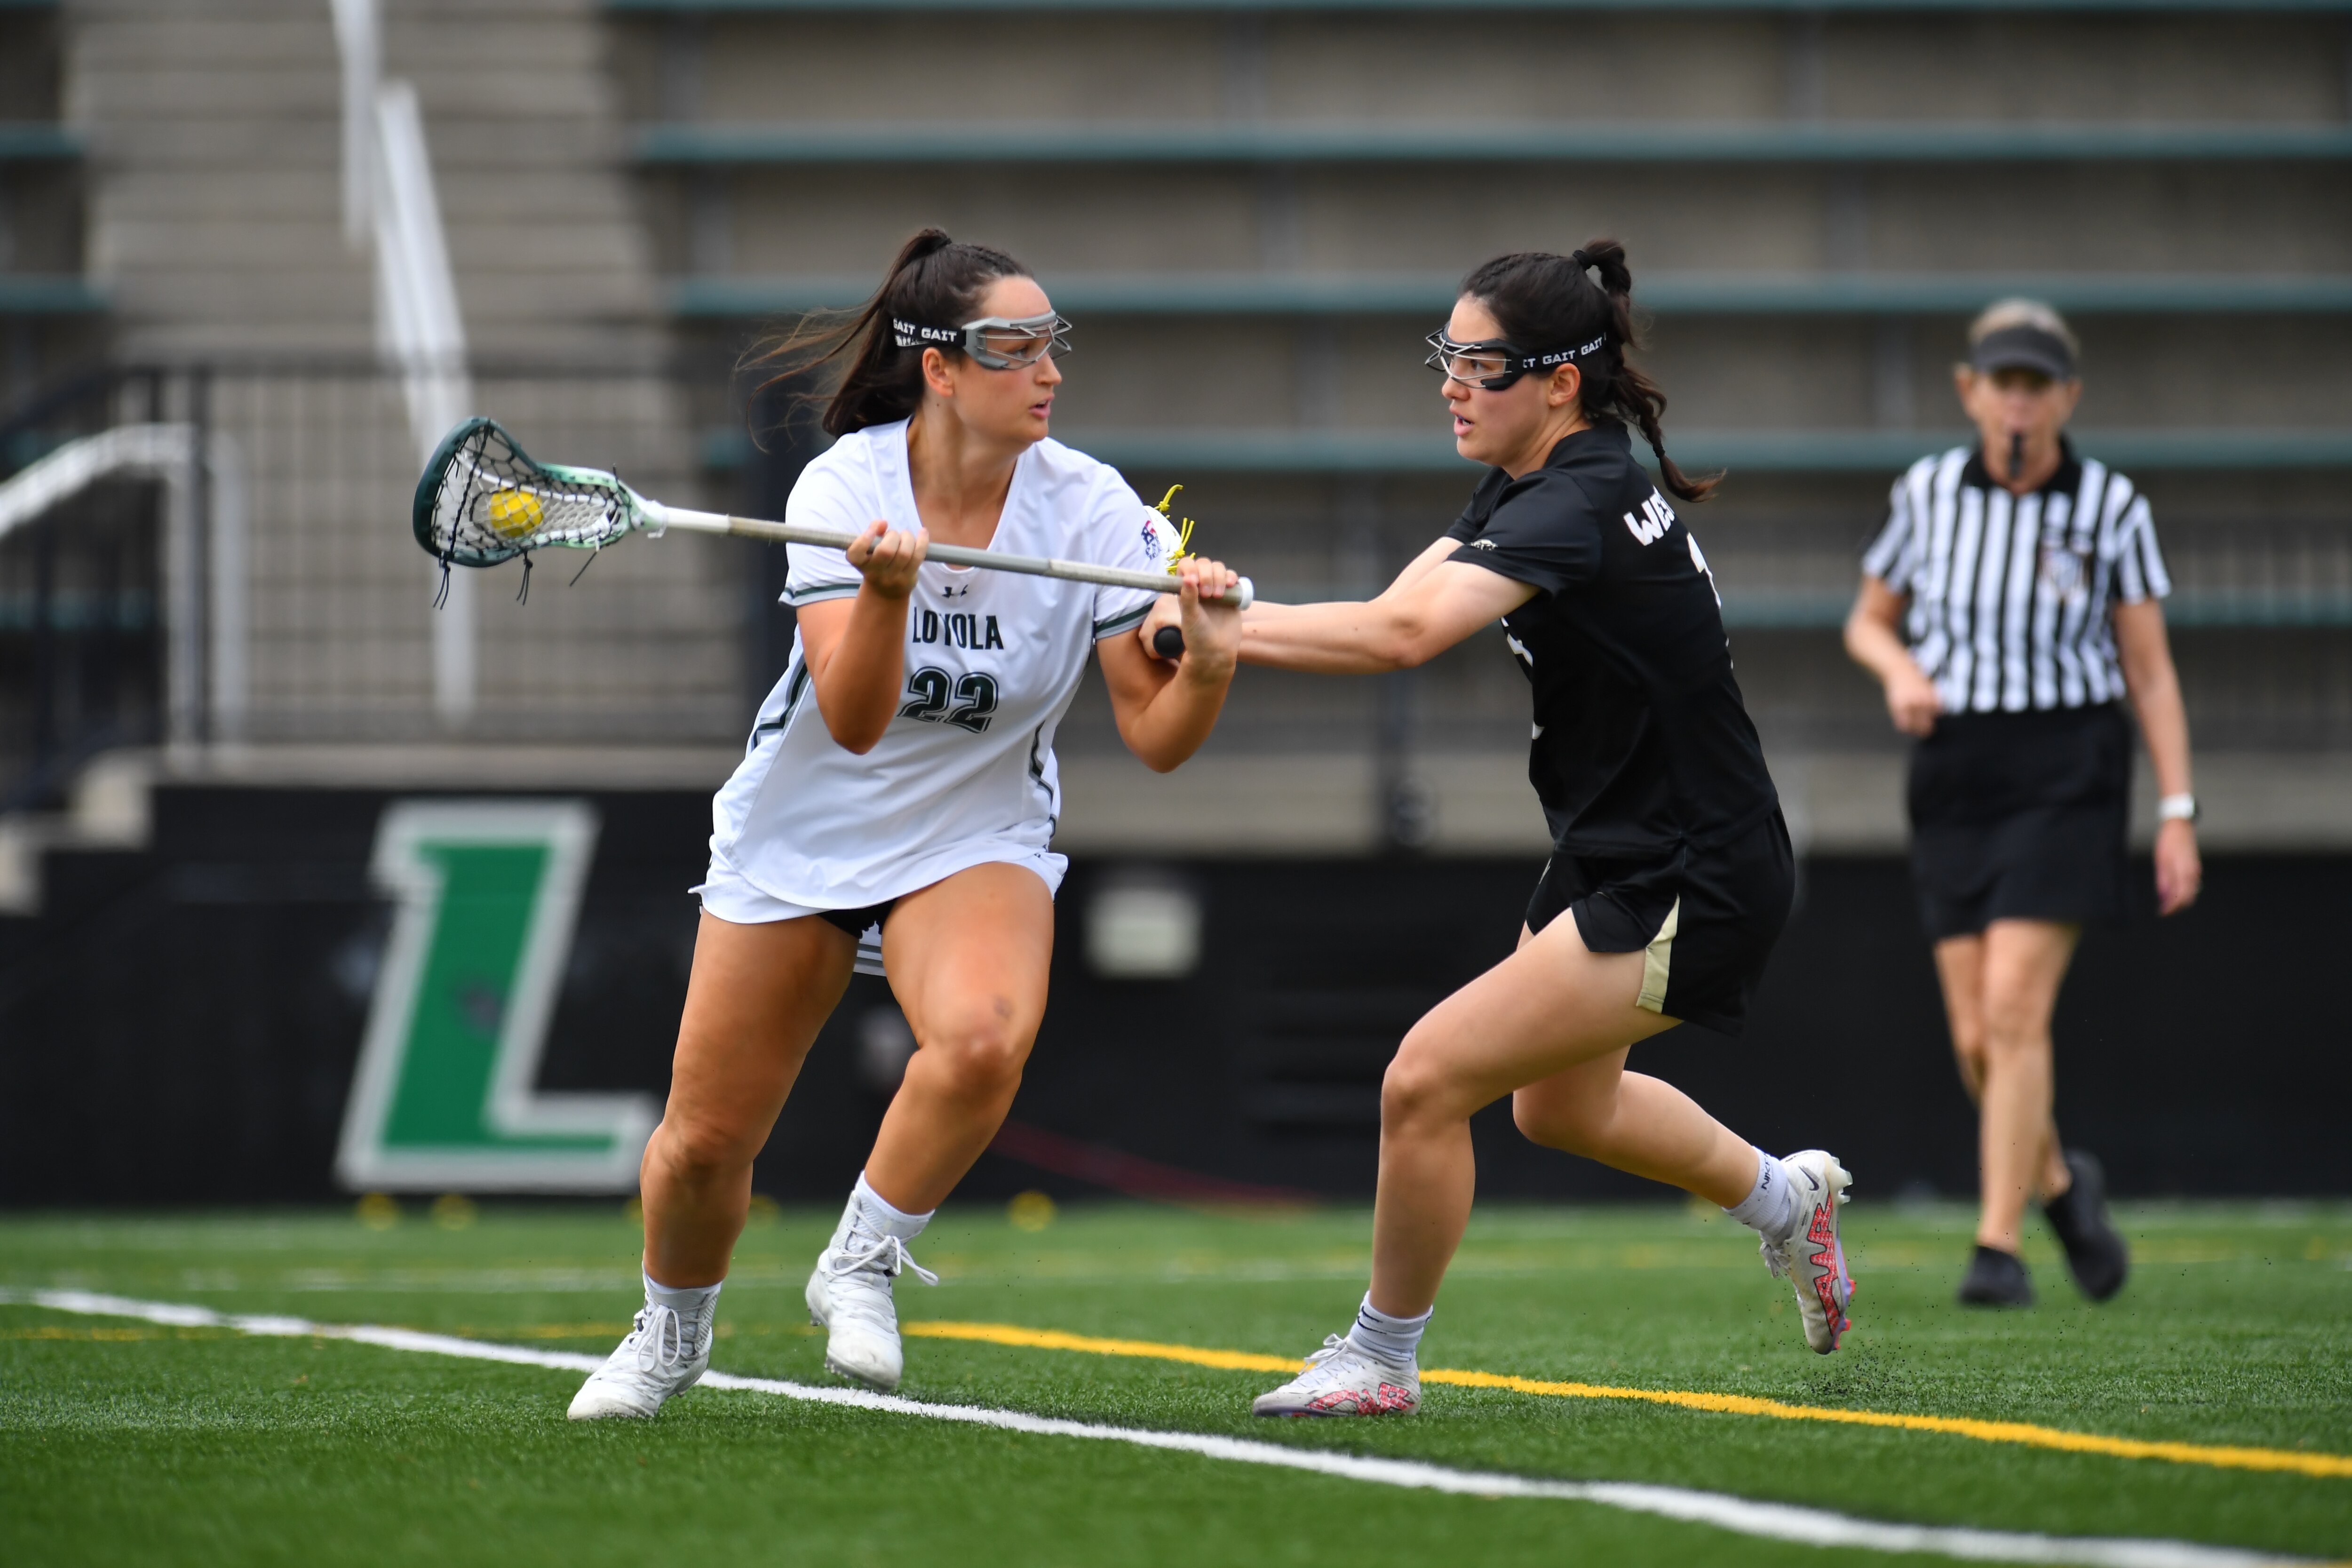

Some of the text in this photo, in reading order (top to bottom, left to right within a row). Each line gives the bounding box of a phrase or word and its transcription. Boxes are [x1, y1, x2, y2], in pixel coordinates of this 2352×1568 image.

[922, 327, 957, 342] GAIT
[1542, 350, 1575, 365] GAIT
[1581, 337, 1603, 356] GAIT
[913, 606, 1004, 650] LOYOLA
[896, 666, 999, 734] 22
[336, 801, 659, 1191] L
